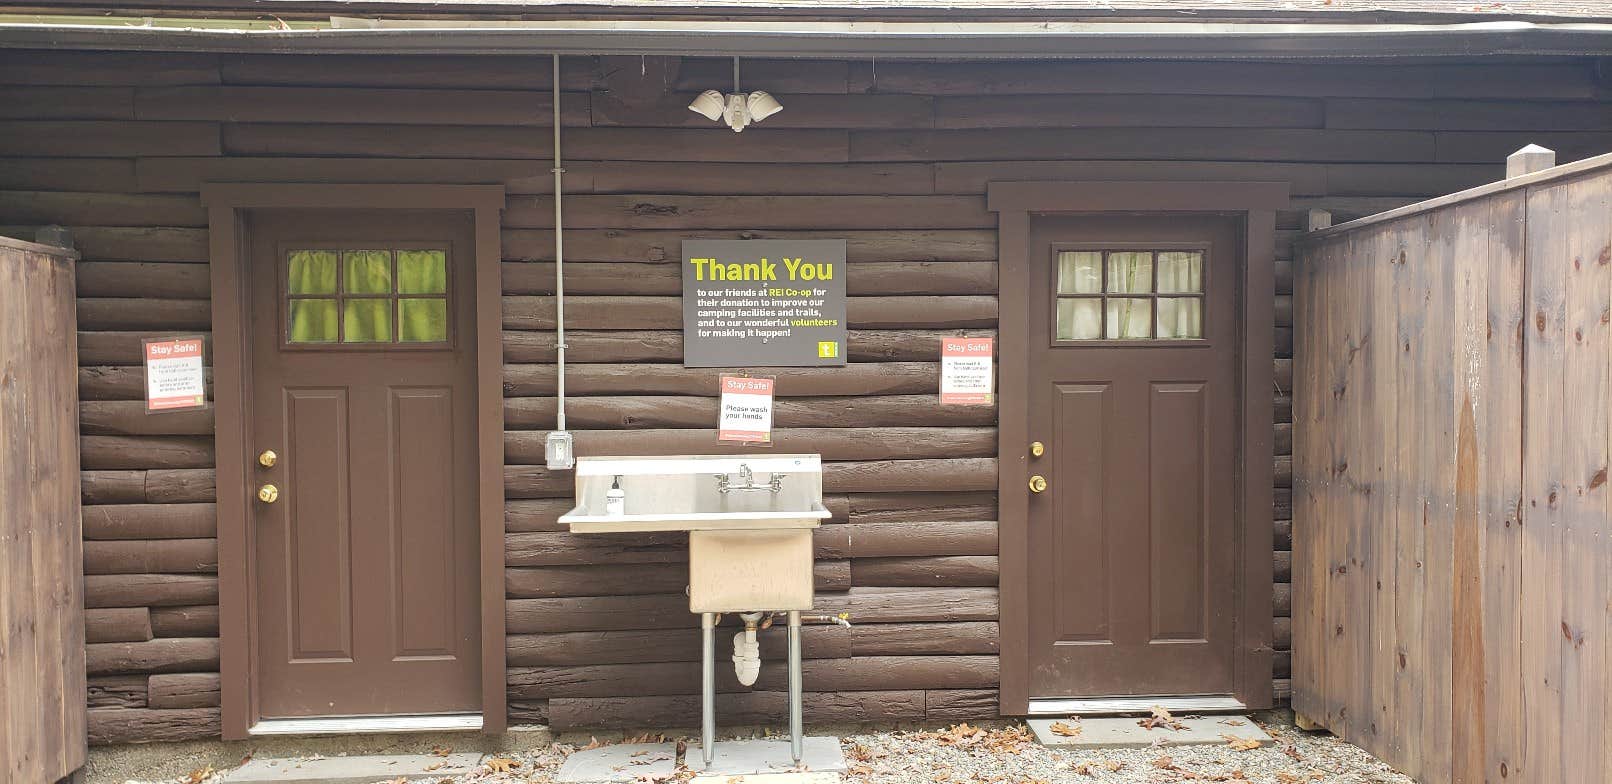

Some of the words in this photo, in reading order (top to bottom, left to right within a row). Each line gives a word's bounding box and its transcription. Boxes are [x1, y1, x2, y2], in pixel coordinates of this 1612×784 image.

[690, 258, 776, 281] Thank
[783, 258, 833, 281] You
[697, 289, 706, 297] to
[708, 289, 724, 297] our
[725, 288, 756, 297] friends
[759, 289, 768, 297] at
[769, 288, 784, 297] REI
[786, 288, 811, 298] Co-op
[813, 288, 826, 297] for
[697, 299, 718, 307] their
[721, 299, 759, 307] donation
[761, 299, 770, 307] to
[772, 299, 808, 308] improve
[810, 299, 824, 307] our
[698, 309, 736, 319] camping
[738, 309, 776, 317] facilities
[778, 309, 794, 317] and
[796, 309, 822, 317] trails,
[698, 319, 714, 327] and
[717, 319, 725, 327] to
[744, 319, 789, 327] wonderful
[698, 329, 711, 337] for
[713, 329, 745, 338] making
[747, 329, 754, 337] it
[755, 329, 791, 339] happen!
[151, 344, 172, 355] Stay
[174, 344, 197, 353] Safe!
[947, 343, 965, 352] Stay
[968, 343, 989, 352] Safe!
[727, 380, 746, 390] Stay
[748, 381, 769, 390] Safe!
[726, 404, 749, 412] Please
